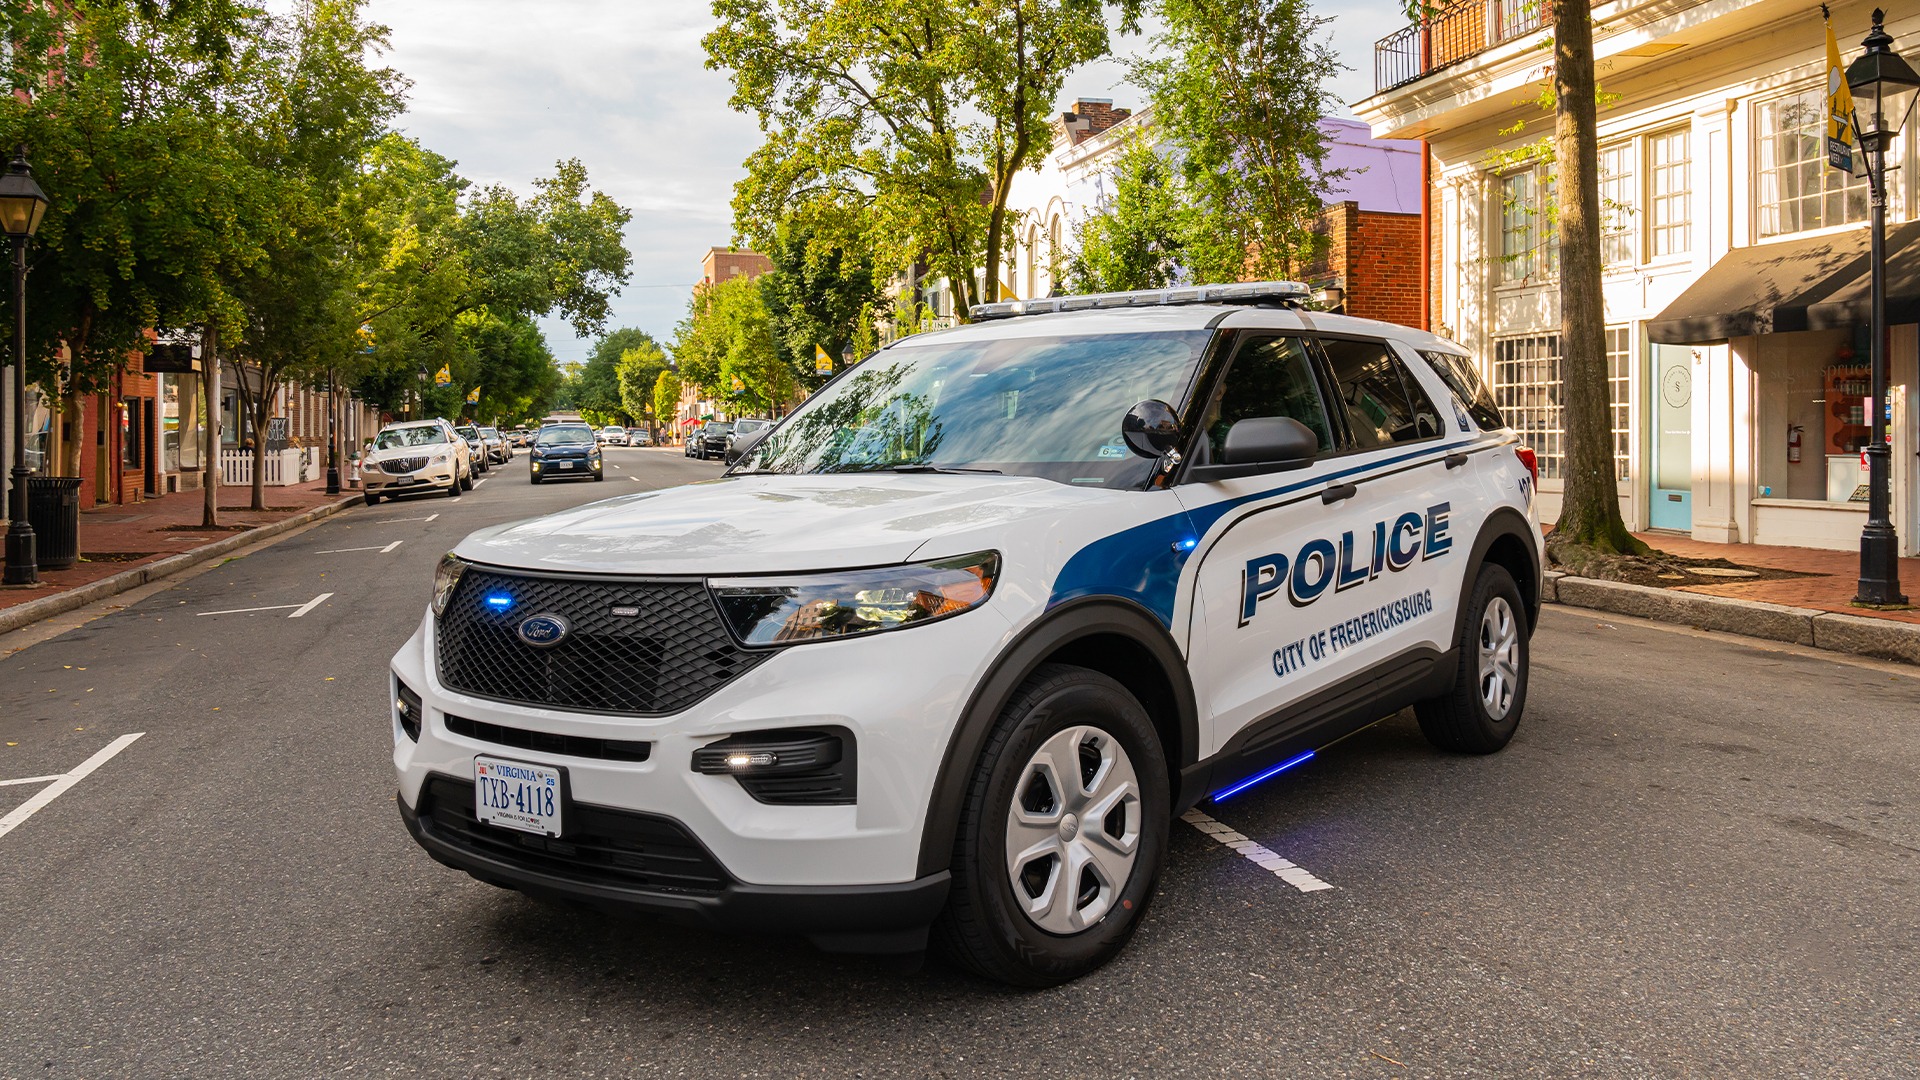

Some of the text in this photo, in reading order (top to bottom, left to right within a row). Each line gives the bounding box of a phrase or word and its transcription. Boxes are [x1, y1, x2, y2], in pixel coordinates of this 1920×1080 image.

[1819, 362, 1872, 382] spruce
[268, 429, 286, 441] OUR
[1237, 501, 1453, 629] POLICE
[527, 621, 553, 638] Ford
[1272, 588, 1433, 678] CITY OF FREDERICKSBURG
[479, 767, 487, 775] JUL
[496, 764, 537, 782] VIRGINIA
[547, 778, 555, 786] 25
[480, 776, 555, 817] TXB-4118
